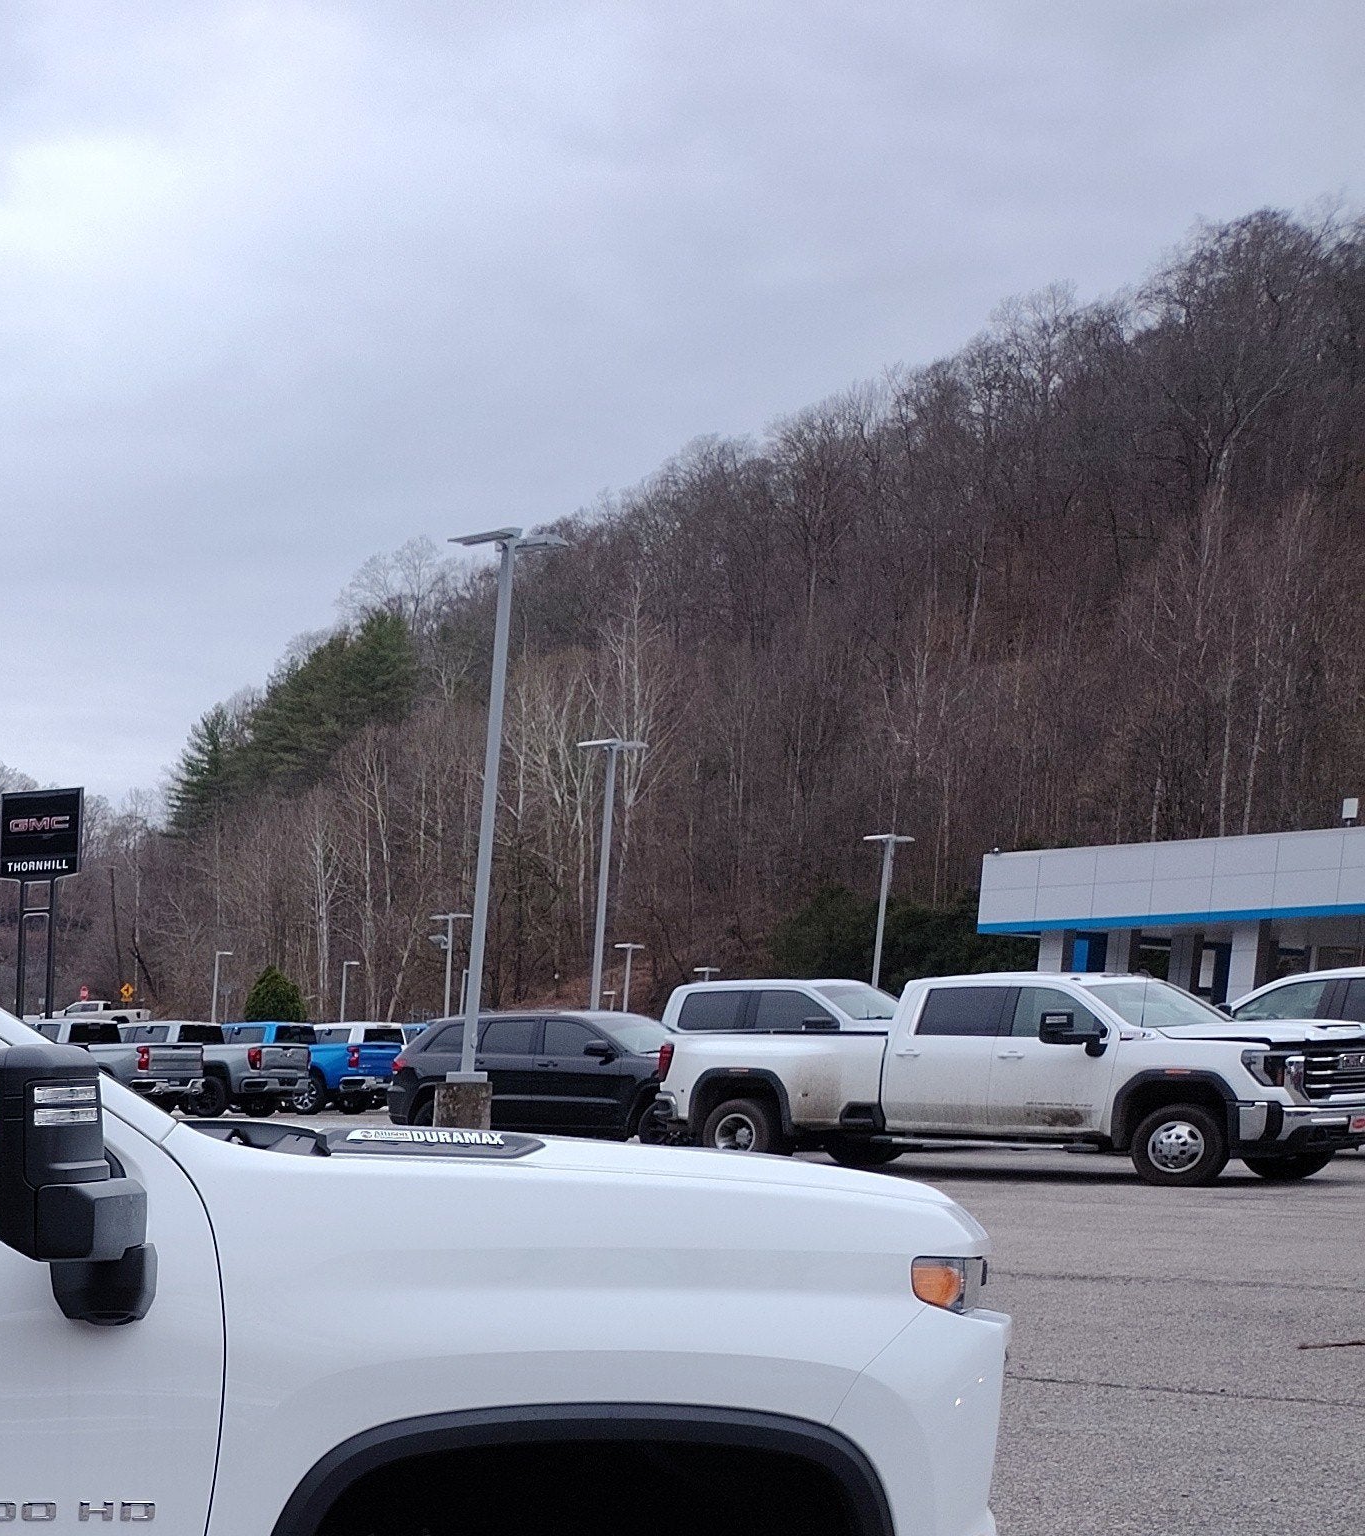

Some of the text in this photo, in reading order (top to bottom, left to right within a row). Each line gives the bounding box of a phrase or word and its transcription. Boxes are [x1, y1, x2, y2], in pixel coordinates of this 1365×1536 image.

[9, 815, 70, 833] GMC
[7, 859, 69, 872] THORNHILL
[411, 1130, 505, 1146] DURAMAX
[78, 1500, 156, 1522] HD
